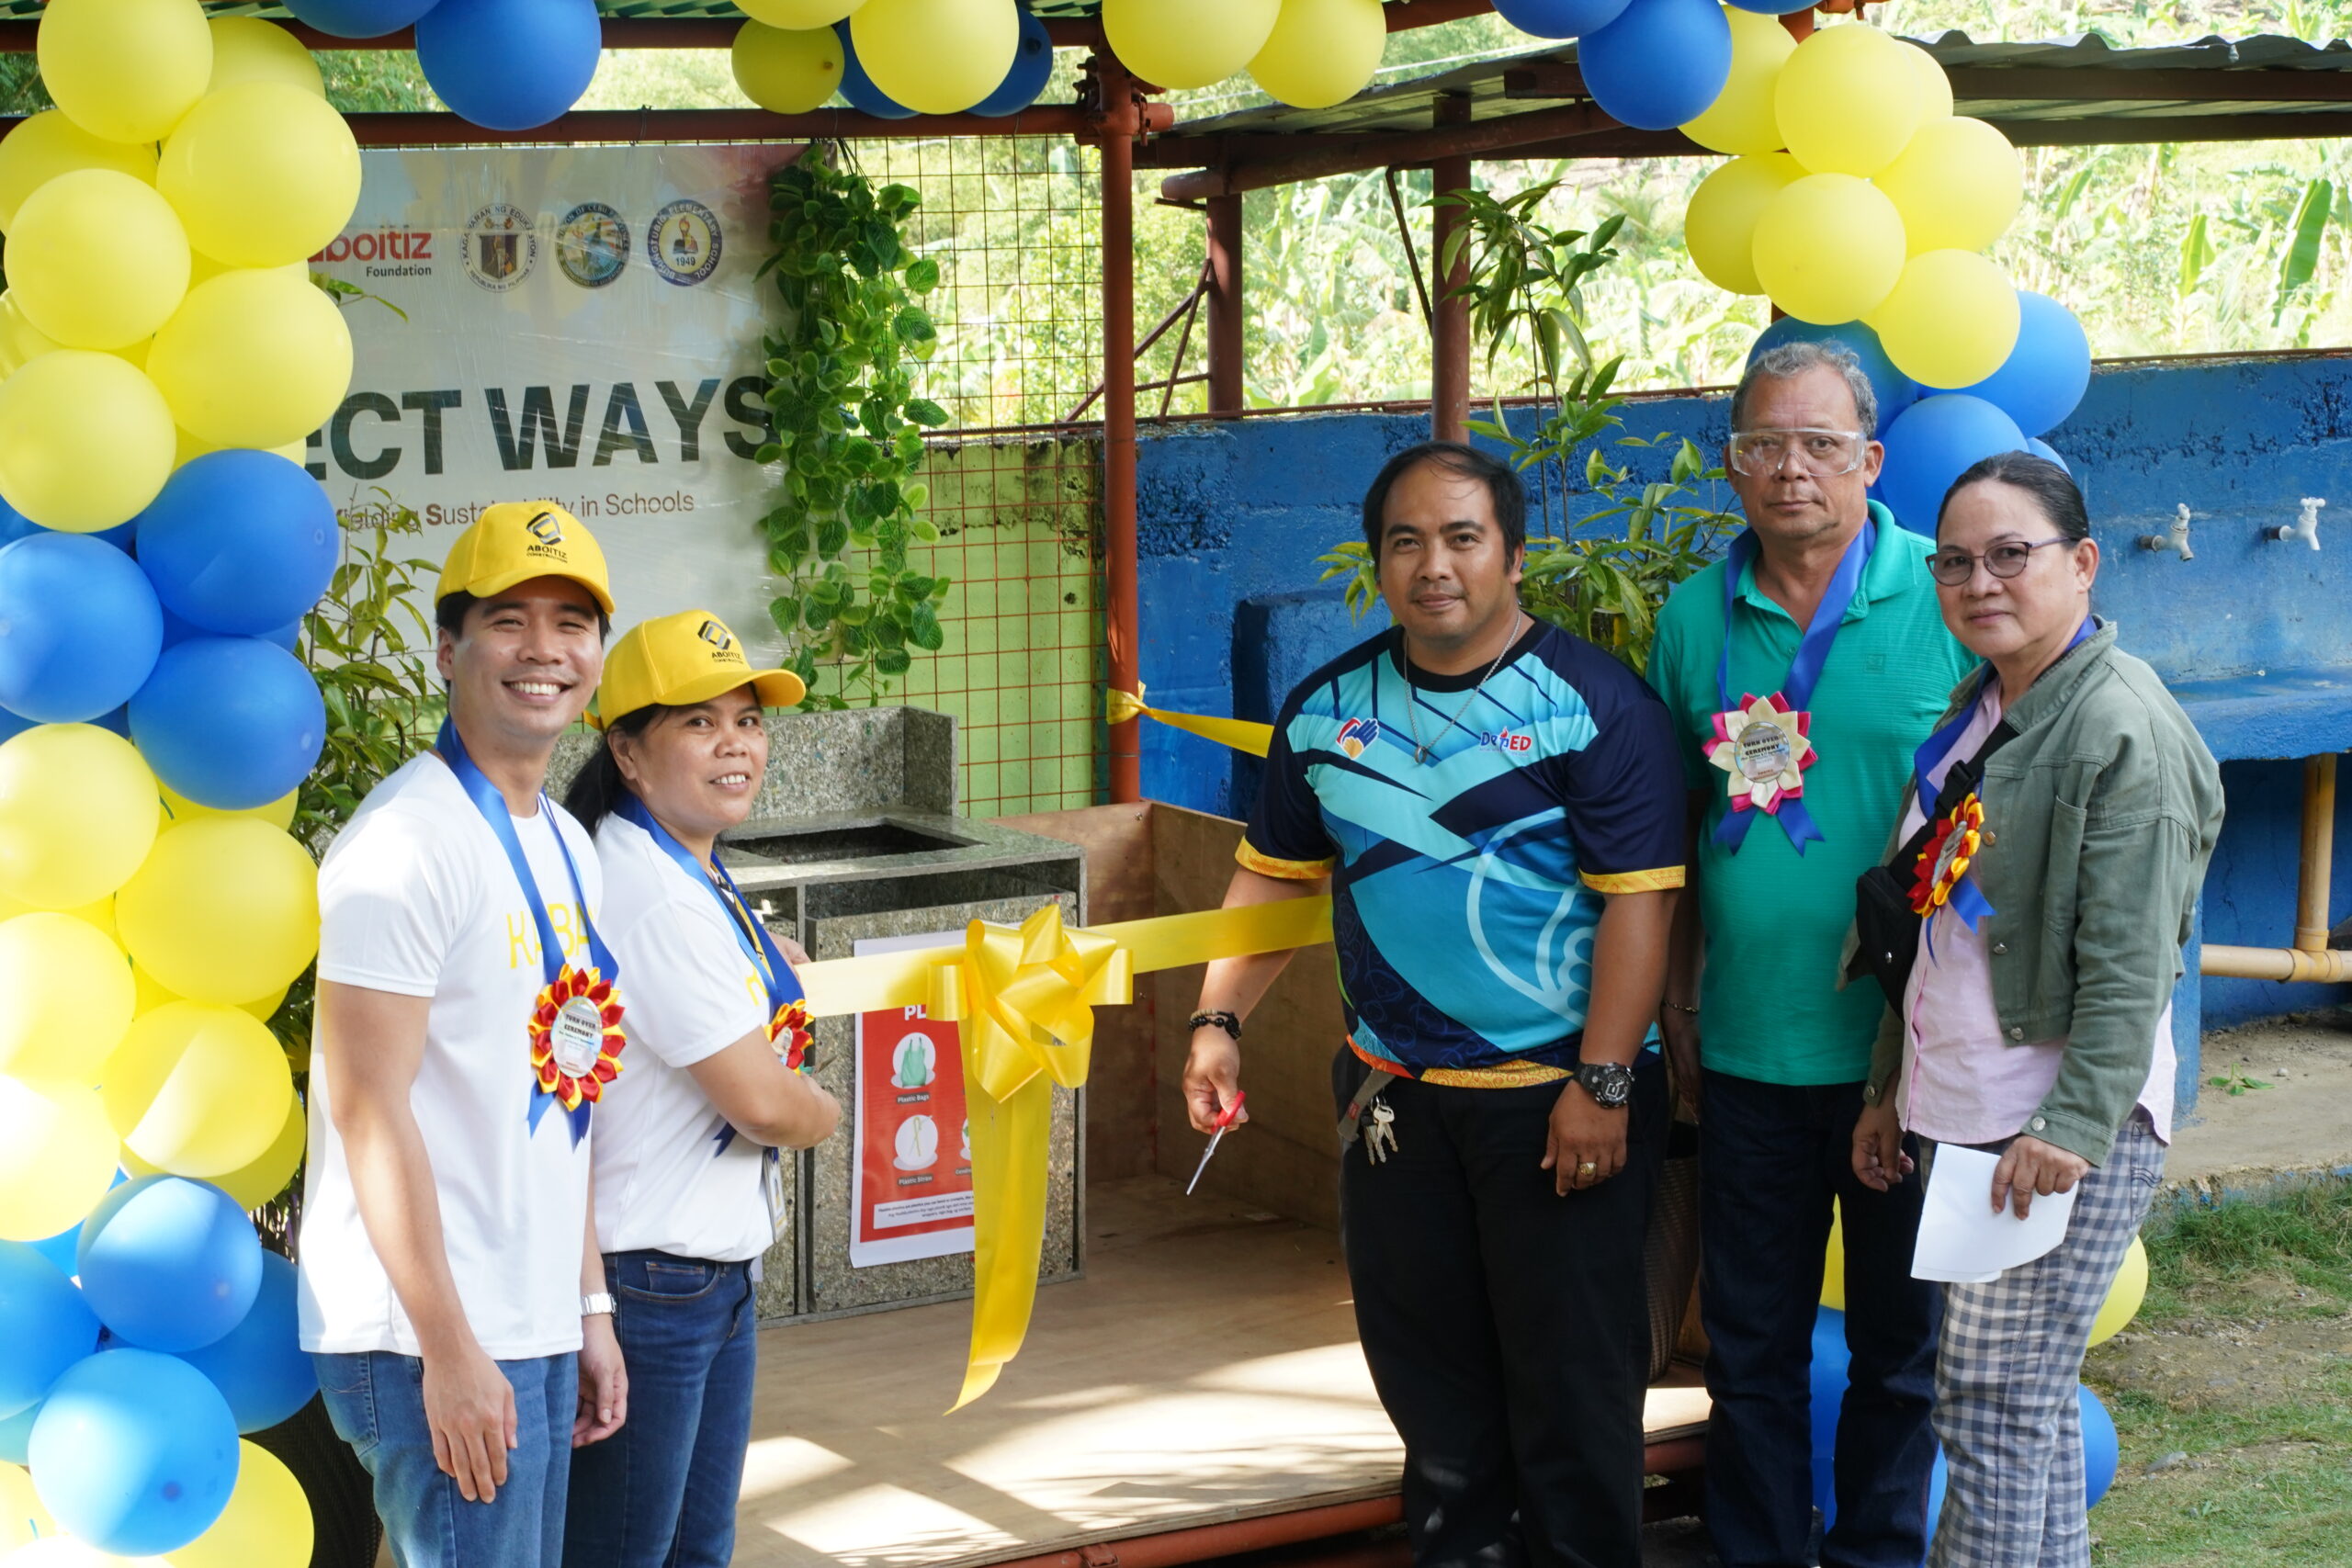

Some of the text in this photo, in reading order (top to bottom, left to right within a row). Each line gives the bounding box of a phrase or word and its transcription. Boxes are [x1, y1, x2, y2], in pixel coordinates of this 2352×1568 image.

[494, 206, 507, 214] NG
[675, 256, 696, 266] 1949
[695, 243, 719, 279] SCHOOL
[366, 265, 432, 277] Foundation
[484, 376, 779, 471] WAYS
[581, 495, 598, 517] in
[605, 491, 695, 516] Schools
[526, 544, 568, 559] ABOITIZ
[1480, 729, 1532, 752] DepED
[1743, 736, 1780, 748] TURN OVER
[1746, 743, 1780, 756] CEREMONY
[565, 1013, 596, 1030] TURN OVER
[564, 1023, 594, 1038] CEREMONY
[897, 1093, 930, 1103] Plastic Bags
[899, 1177, 917, 1185] Plastic
